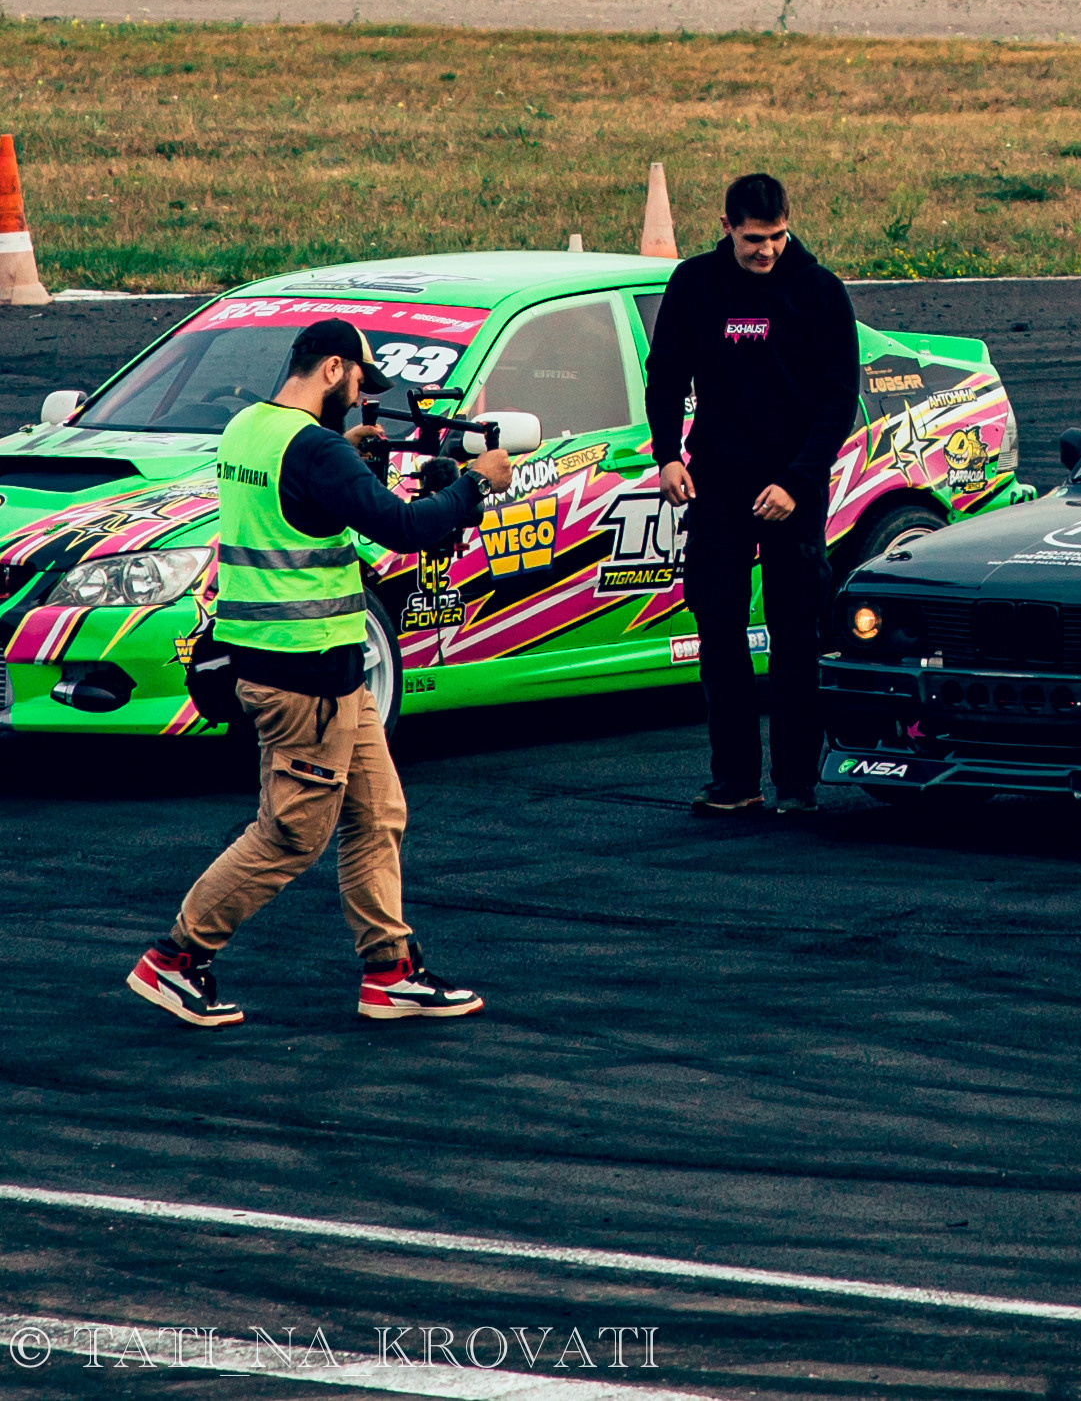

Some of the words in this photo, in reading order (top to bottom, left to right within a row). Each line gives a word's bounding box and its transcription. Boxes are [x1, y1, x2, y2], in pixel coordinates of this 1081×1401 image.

[210, 299, 296, 322] RDS
[310, 302, 382, 316] EUROPE
[726, 323, 768, 334] EXHAUST
[372, 342, 459, 383] 33
[562, 449, 600, 470] SERVICE
[482, 521, 556, 558] WEGO
[604, 568, 674, 586] TIGRAN.CS
[412, 593, 457, 612] SLIDE
[405, 607, 463, 628] POWER
[852, 760, 909, 778] NSA
